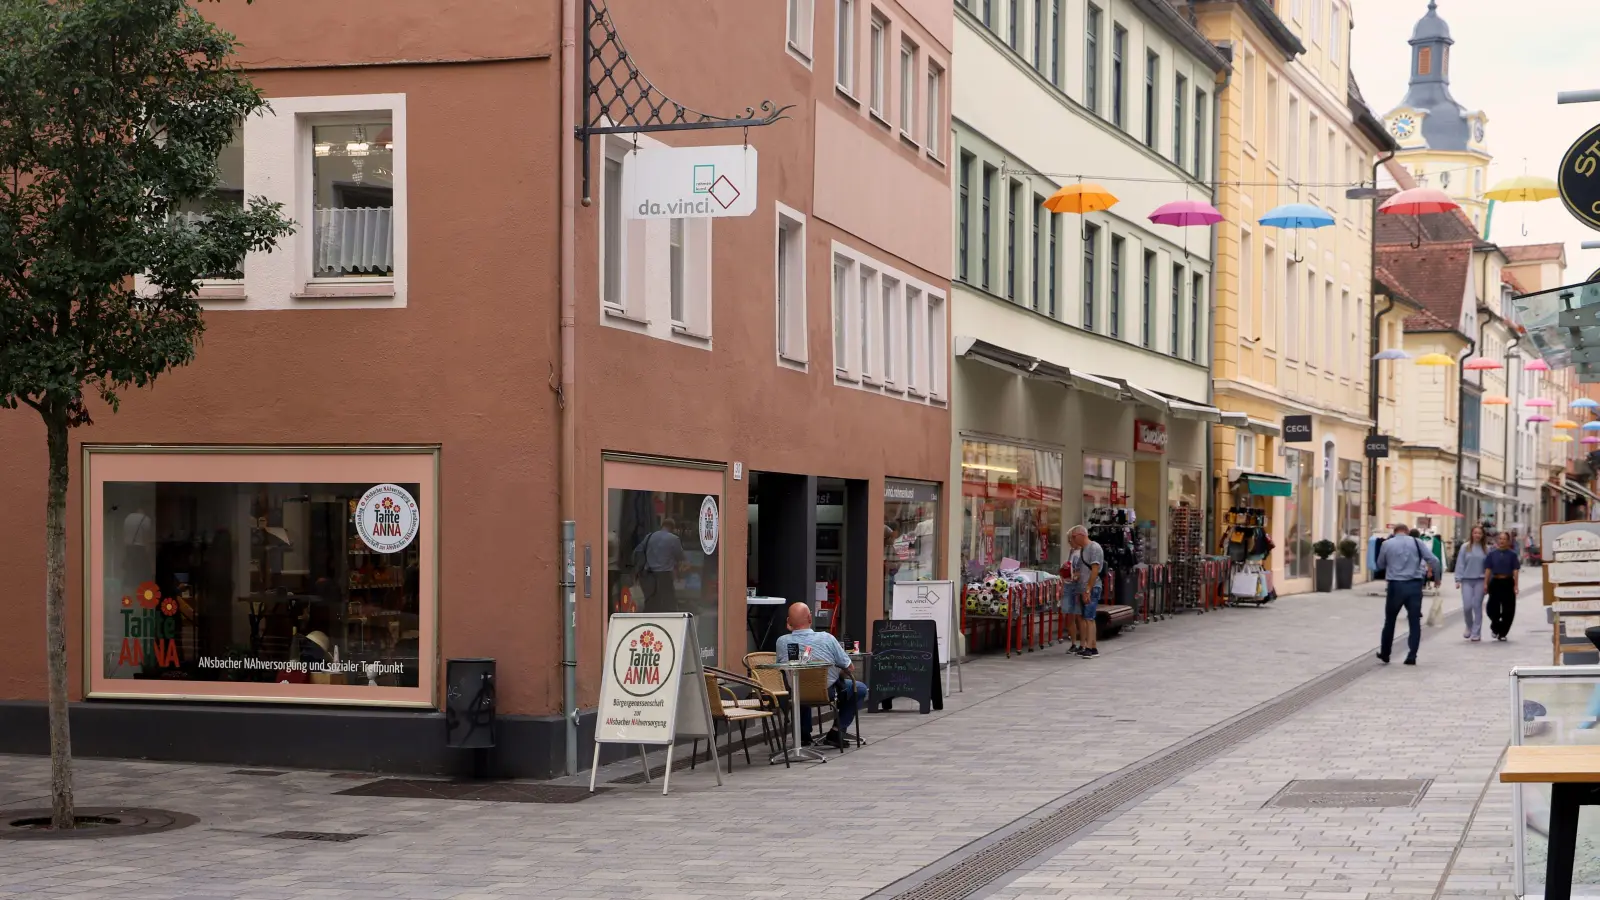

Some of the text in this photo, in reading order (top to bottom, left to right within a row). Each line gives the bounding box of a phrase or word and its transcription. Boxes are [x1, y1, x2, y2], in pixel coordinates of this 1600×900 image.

[639, 198, 714, 215] da.vinci.
[374, 510, 400, 523] Tante
[373, 523, 401, 536] ANNA
[118, 637, 180, 668] ANNA
[629, 647, 661, 667] Tante
[198, 656, 404, 676] ANsbacher NAhversorgung und sozialer Treffpunkt
[623, 666, 660, 685] ANNA
[613, 698, 664, 708] Bürgergenossenschaft
[606, 717, 667, 728] ANsbacher NAhversorgung
